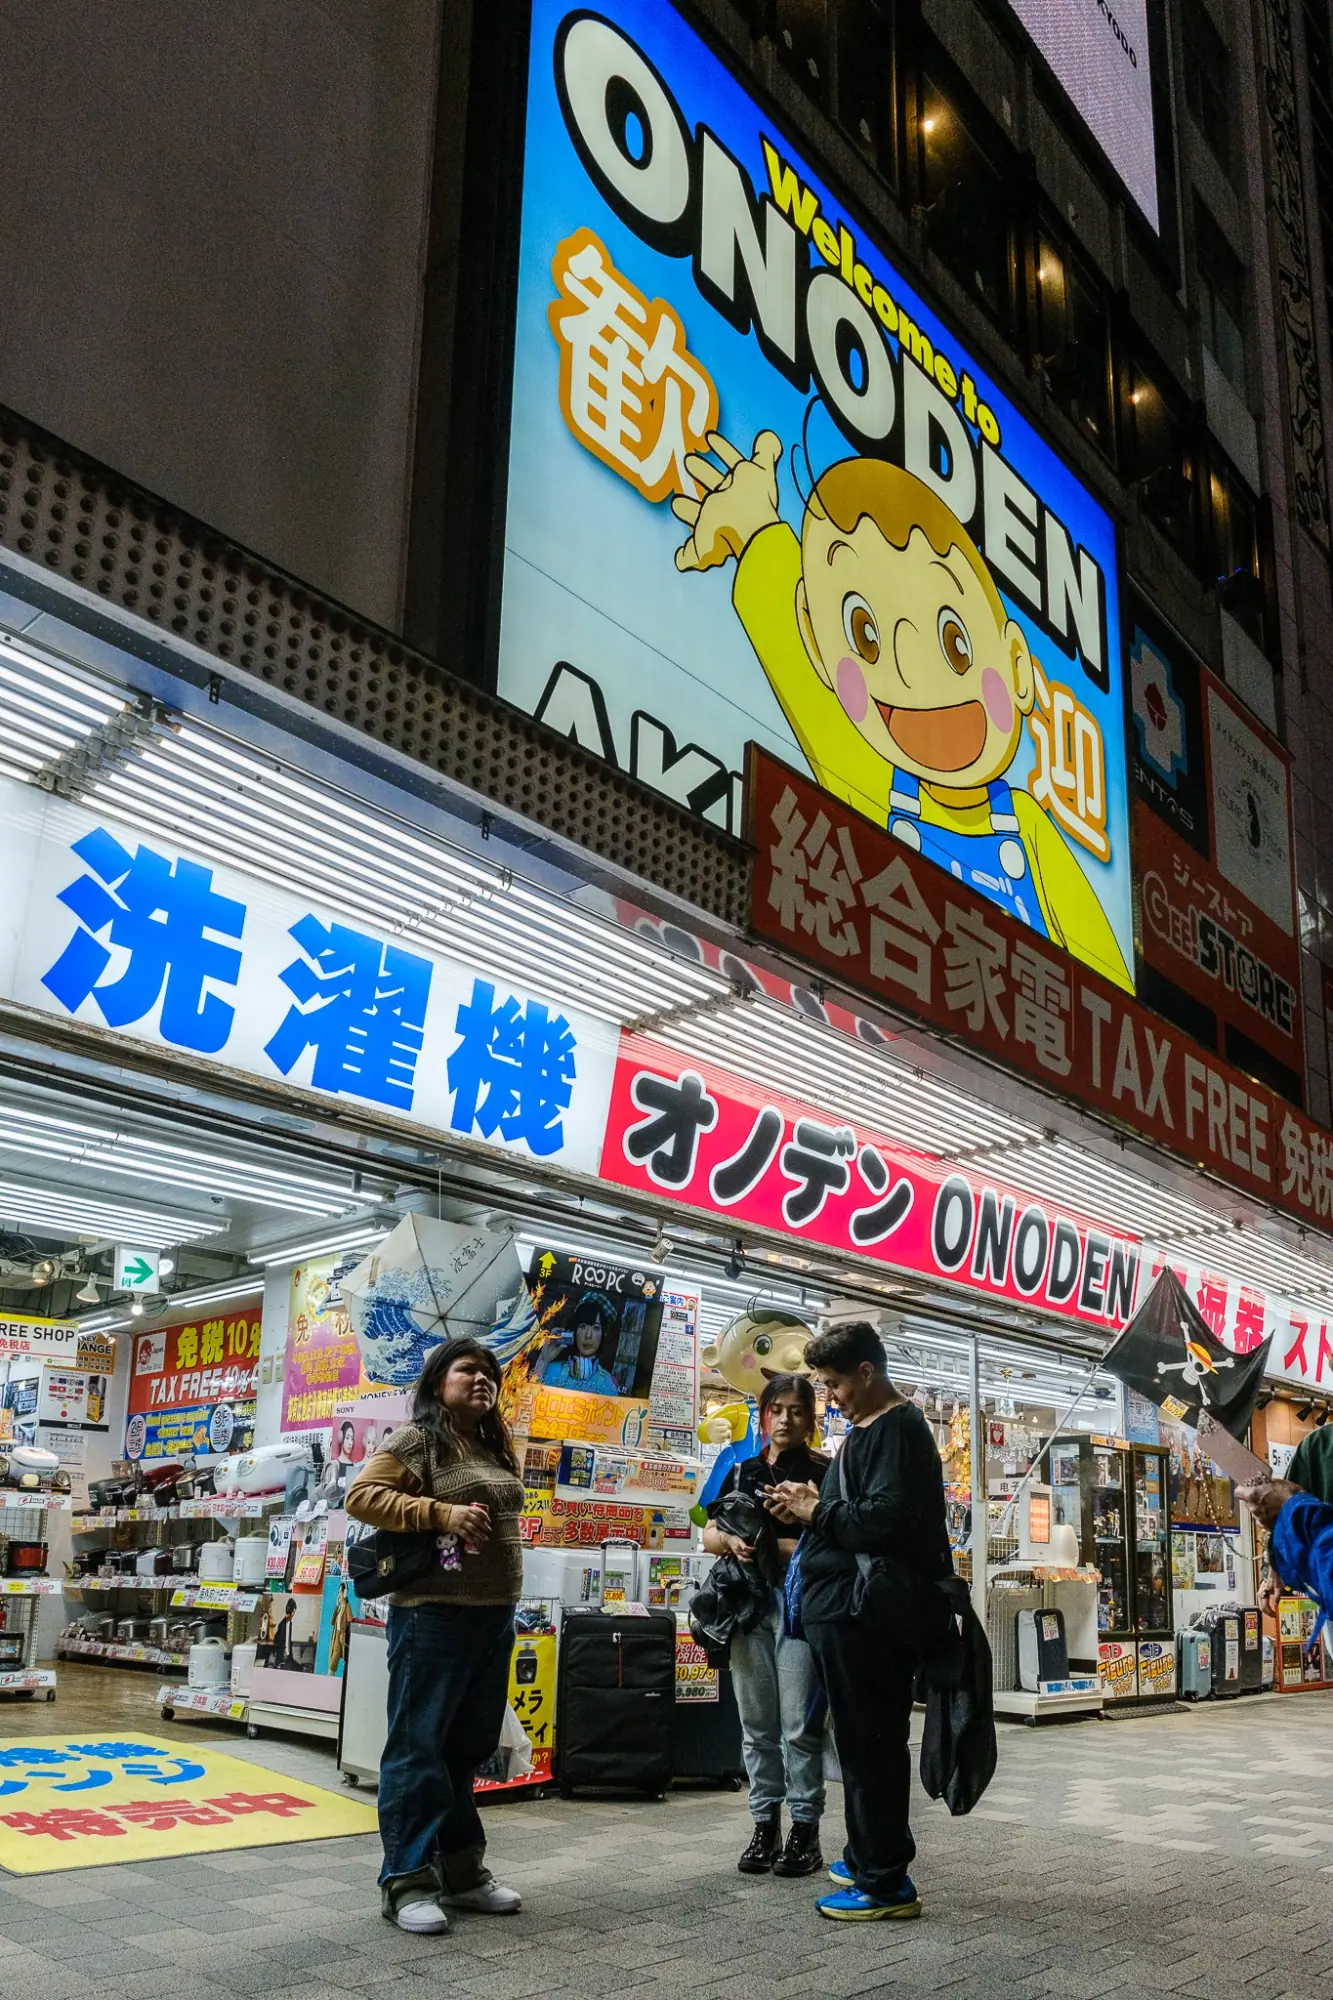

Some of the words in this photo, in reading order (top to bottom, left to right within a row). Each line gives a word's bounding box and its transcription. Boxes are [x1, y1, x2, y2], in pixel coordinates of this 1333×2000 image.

[760, 131, 957, 399] Welcome
[960, 367, 1002, 446] to
[555, 10, 1108, 692] ONODEN
[1028, 658, 1109, 860] 迎
[1172, 853, 1254, 937] ジーストア
[766, 784, 1071, 1077] 総合家電
[41, 826, 578, 1156] 洗濯機
[1081, 985, 1175, 1130] TAX
[1184, 1052, 1271, 1183] FREE
[622, 1069, 914, 1247] オノデン
[931, 1174, 1139, 1322] ONODEN
[539, 1267, 553, 1279] 3F
[0, 1338, 31, 1351] 免税店
[33, 1326, 75, 1343] SHOP
[150, 1373, 179, 1405] TAX
[178, 1367, 222, 1402] FREE
[130, 1420, 143, 1434] 2F
[336, 1406, 355, 1414] SONY
[535, 1391, 625, 1429] ゼロエミポイント
[990, 1423, 1003, 1431] AED
[1272, 1449, 1281, 1467] 5F
[677, 1651, 706, 1663] PRICE
[1098, 1654, 1136, 1683] Figure
[1139, 1653, 1174, 1685] Figure
[513, 1689, 544, 1715] メラ
[0, 1792, 318, 1841] 特売中
